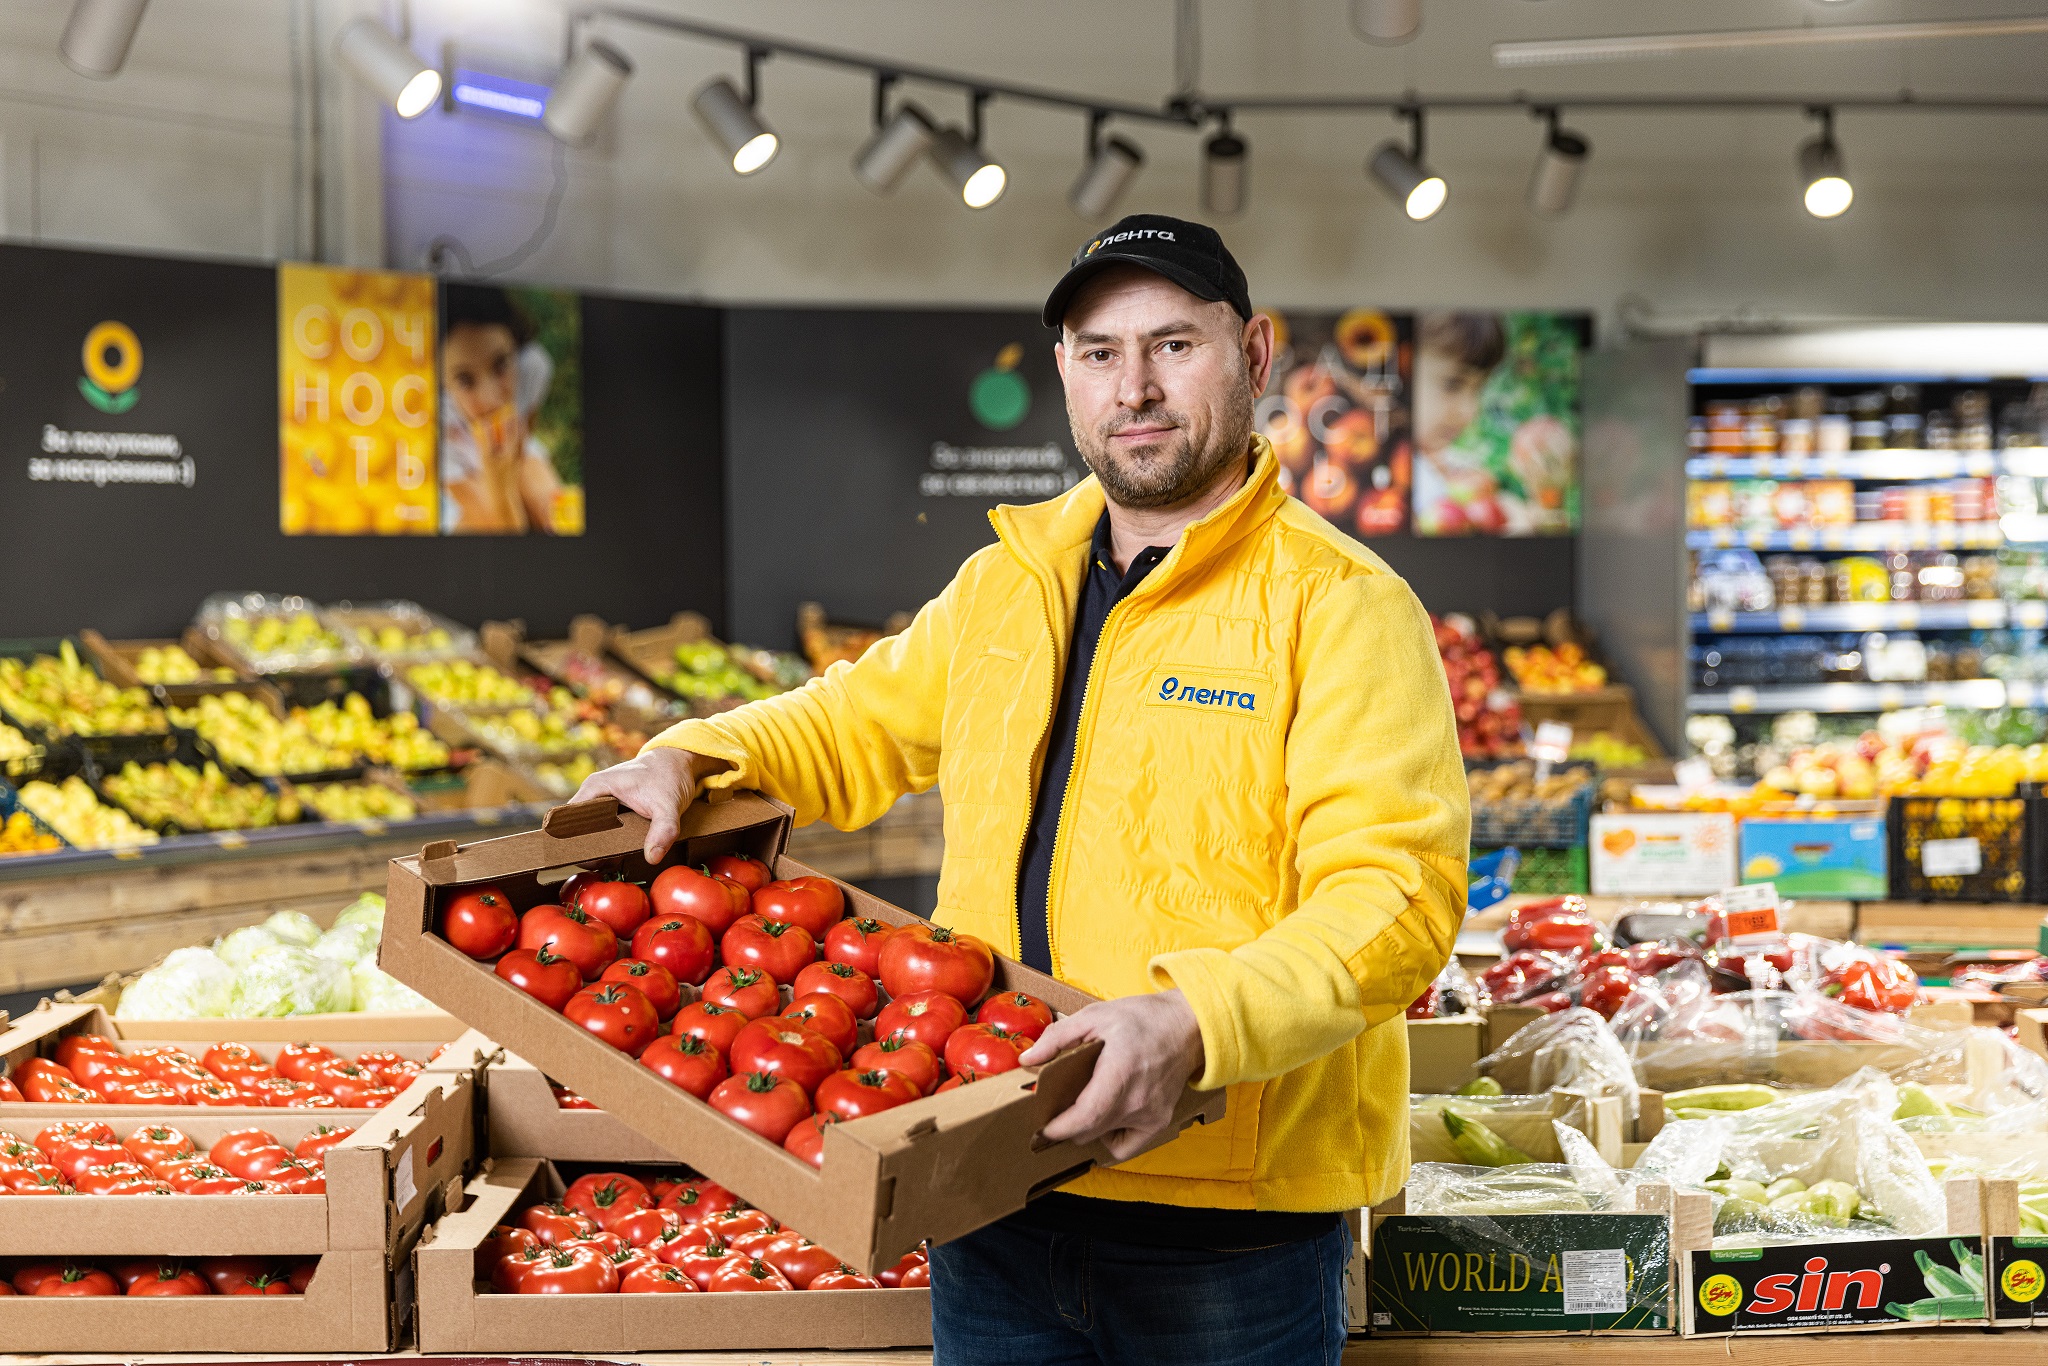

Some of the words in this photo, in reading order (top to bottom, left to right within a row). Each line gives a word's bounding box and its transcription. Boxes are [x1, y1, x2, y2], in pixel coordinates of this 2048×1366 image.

[1099, 230, 1176, 249] лента
[293, 304, 425, 366] СОЧ
[293, 370, 430, 429] НОС
[347, 435, 426, 491] ТЬ
[1177, 686, 1255, 711] лента
[1403, 1252, 1532, 1292] WORLD
